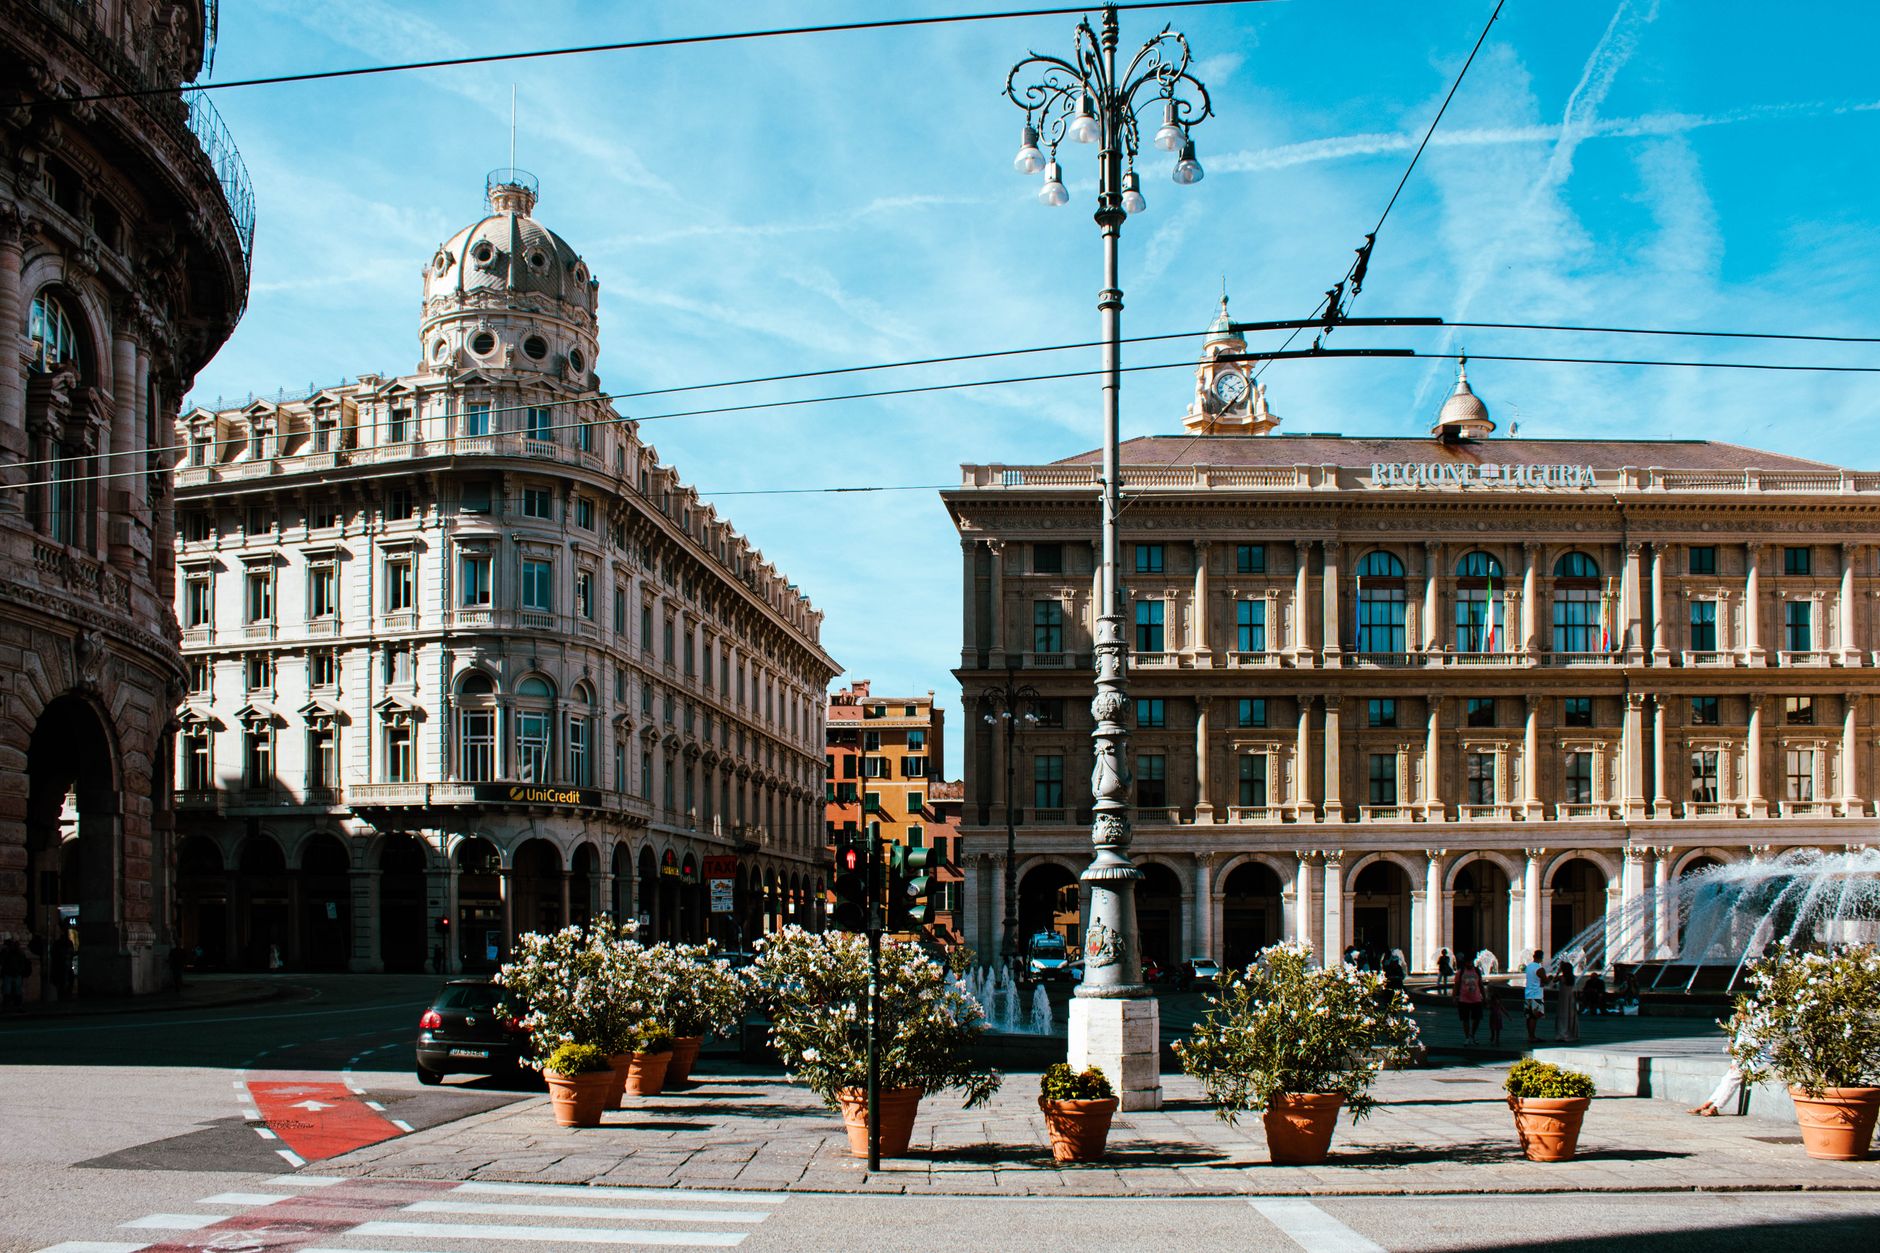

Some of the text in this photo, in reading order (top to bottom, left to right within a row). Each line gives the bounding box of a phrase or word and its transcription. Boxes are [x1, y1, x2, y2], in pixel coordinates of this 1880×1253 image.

[1370, 463, 1598, 488] REGIONE LIGURIA
[526, 788, 580, 804] UniCredit
[705, 861, 736, 874] TAXI
